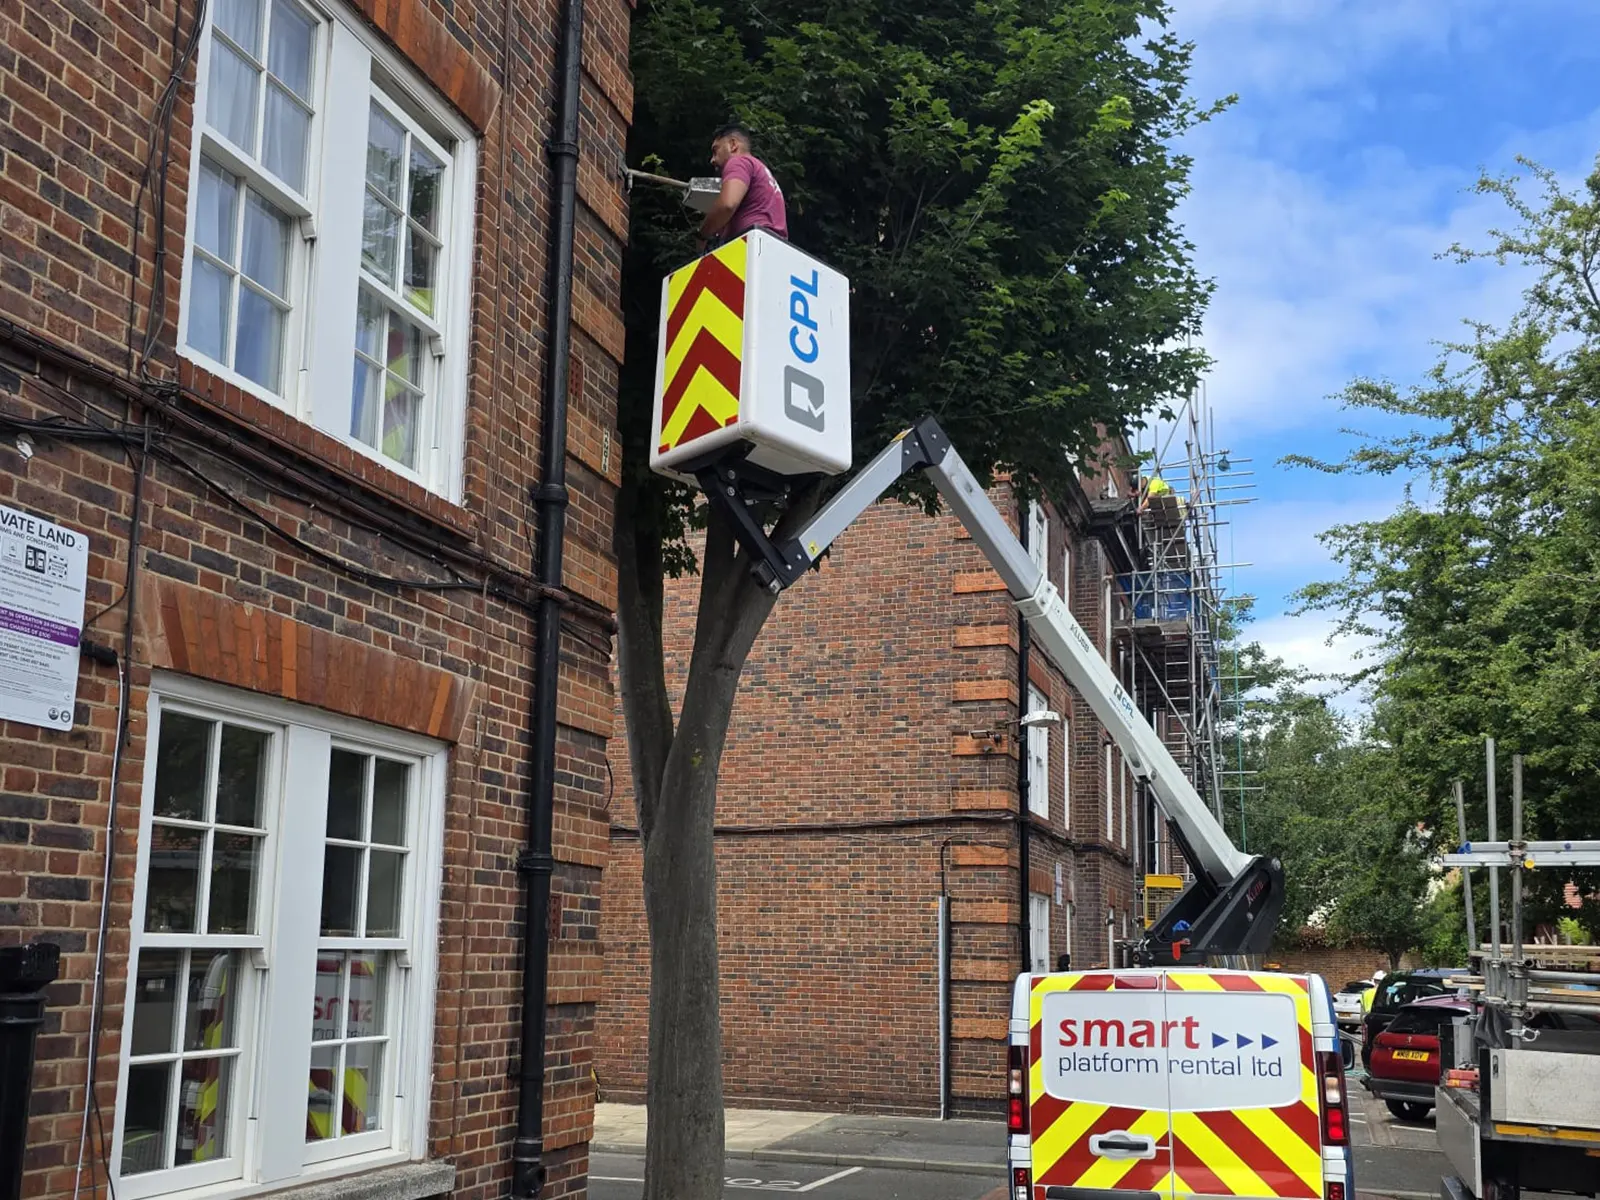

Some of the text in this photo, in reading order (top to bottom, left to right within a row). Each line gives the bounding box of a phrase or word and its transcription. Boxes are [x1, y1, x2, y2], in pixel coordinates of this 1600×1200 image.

[789, 270, 819, 364] CPL
[0, 510, 76, 547] VATE LAND
[13, 530, 25, 540] AND
[26, 535, 60, 551] CONDITIONS
[14, 612, 43, 625] OPERATION
[1121, 697, 1134, 719] CPL
[1059, 1016, 1200, 1049] smart
[1059, 1052, 1283, 1077] platform rental ltd
